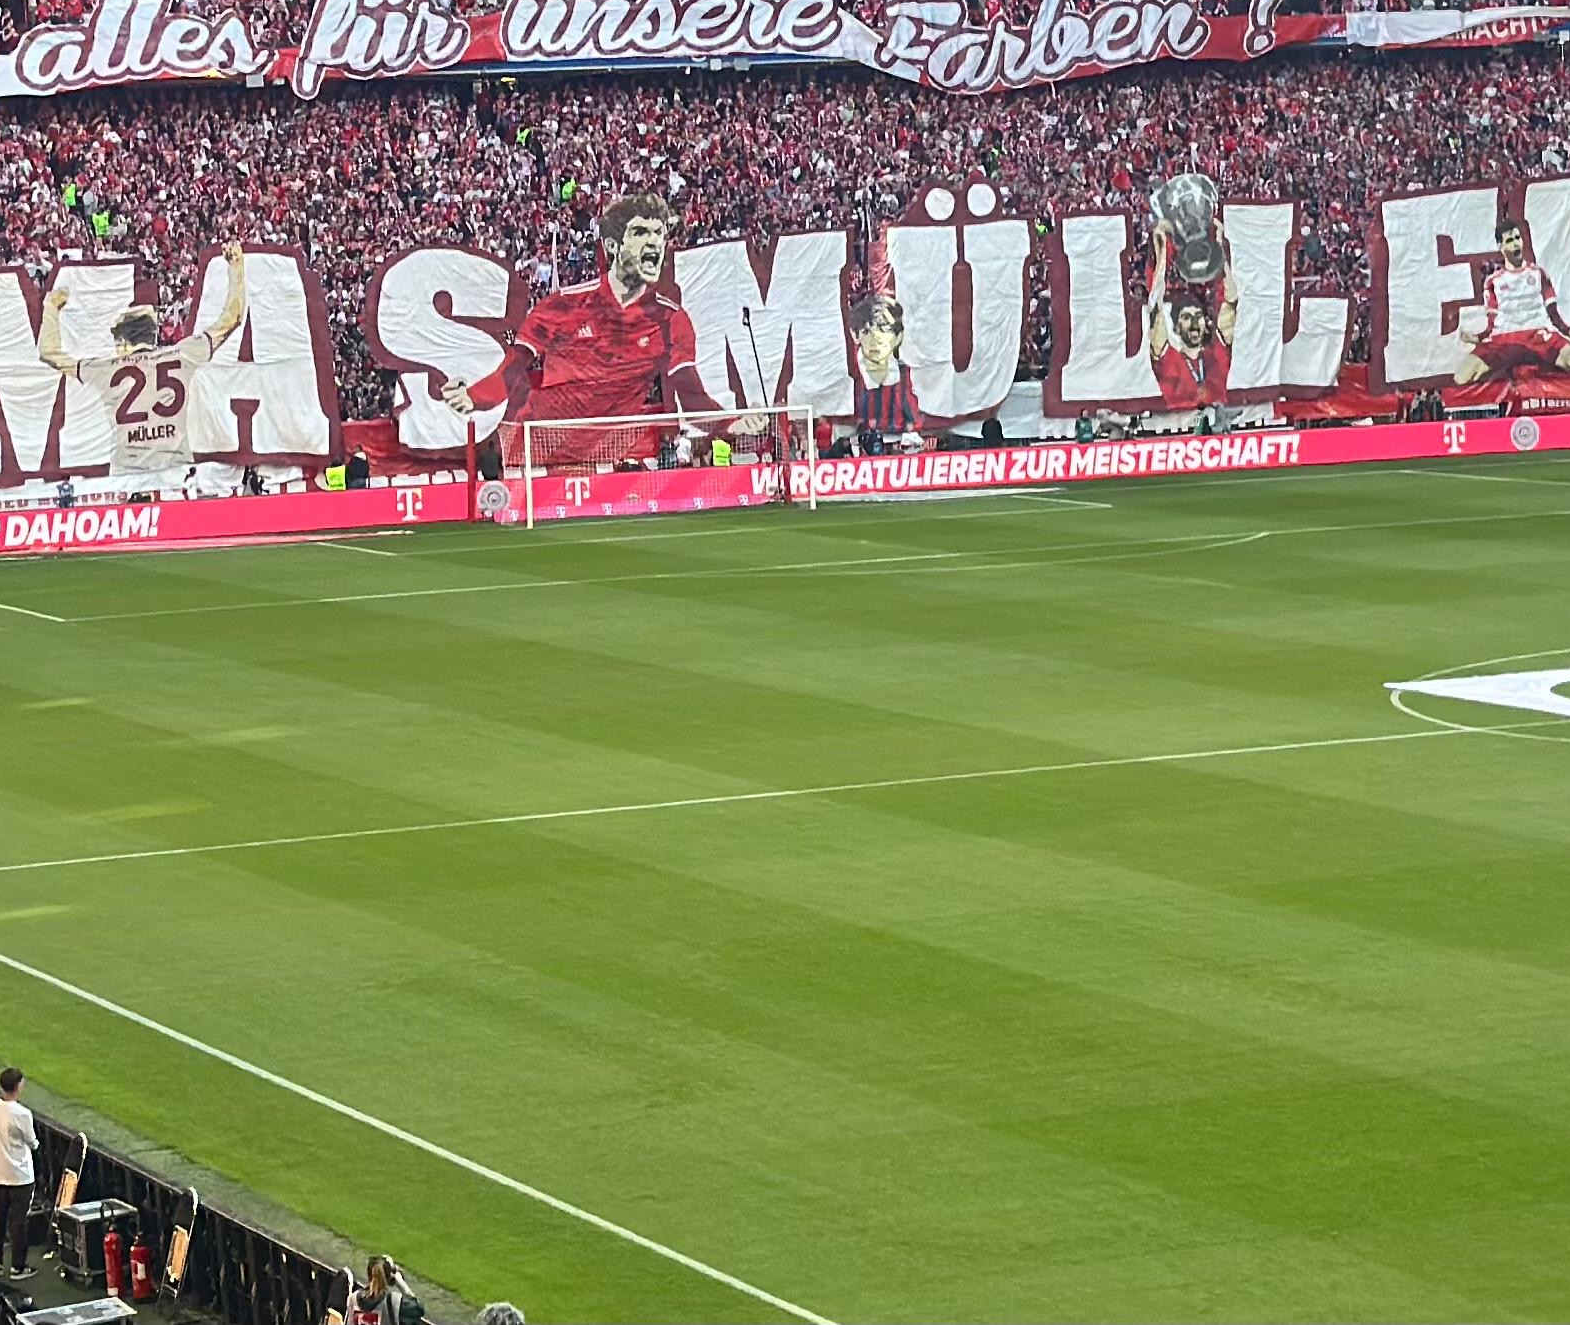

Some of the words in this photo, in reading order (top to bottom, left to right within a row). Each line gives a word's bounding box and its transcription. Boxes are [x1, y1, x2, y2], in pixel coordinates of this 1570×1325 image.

[109, 359, 186, 425] 25
[127, 424, 176, 443] MÜLLER
[751, 465, 810, 495] WR
[814, 453, 1007, 492] GRATULIEREN
[1011, 448, 1074, 479] ZUR
[1076, 431, 1300, 475] MEISTERSCHAFT!
[4, 505, 162, 550] DAHOAM!
